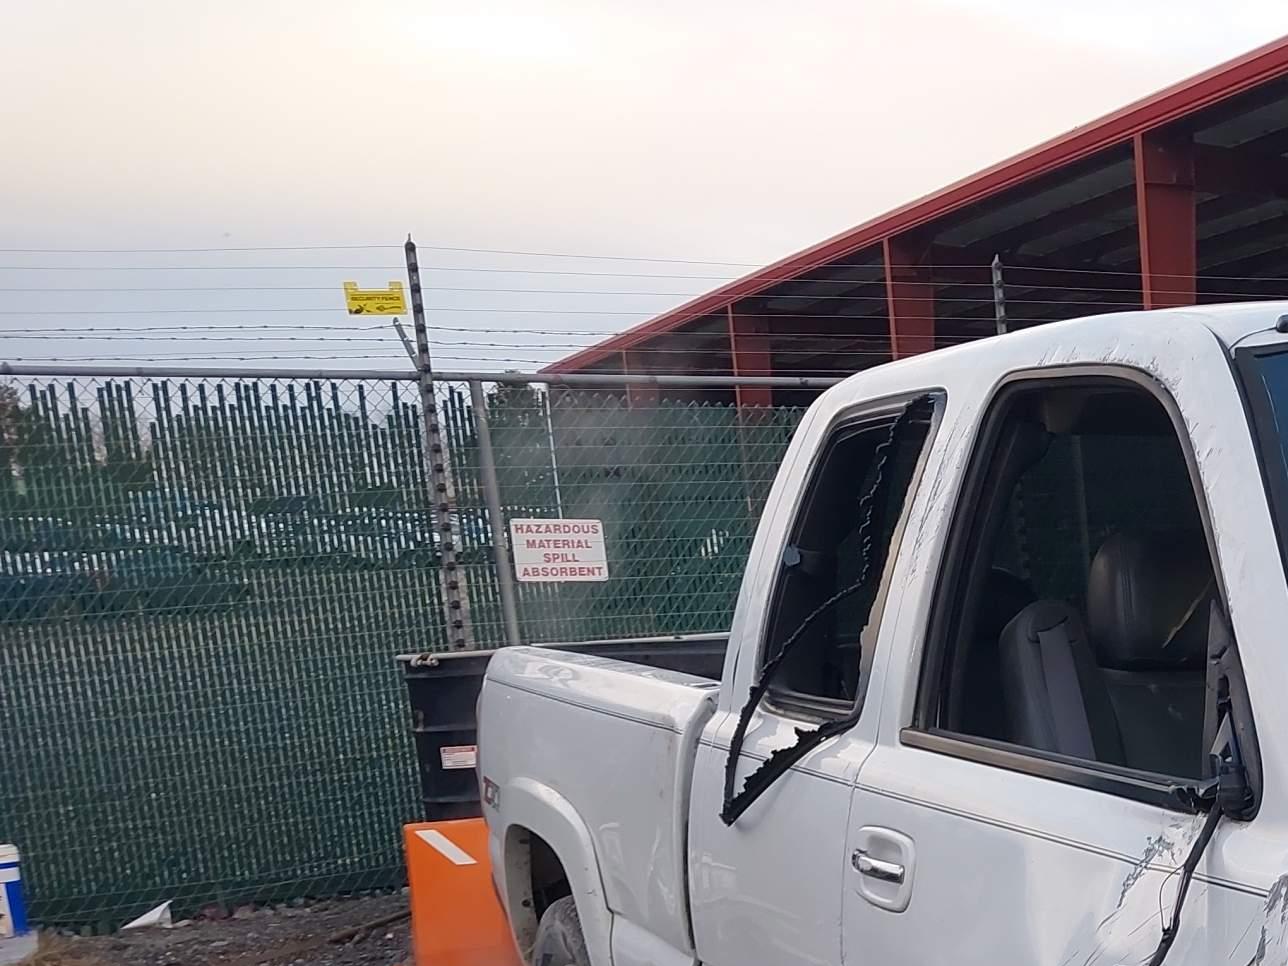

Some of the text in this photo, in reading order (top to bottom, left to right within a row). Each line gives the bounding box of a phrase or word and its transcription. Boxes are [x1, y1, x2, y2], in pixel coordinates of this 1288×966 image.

[514, 524, 599, 534] HAZARDOUS
[526, 539, 593, 549] MATERIAL
[543, 552, 580, 563] SPILL
[522, 566, 604, 577] ABSORBENT
